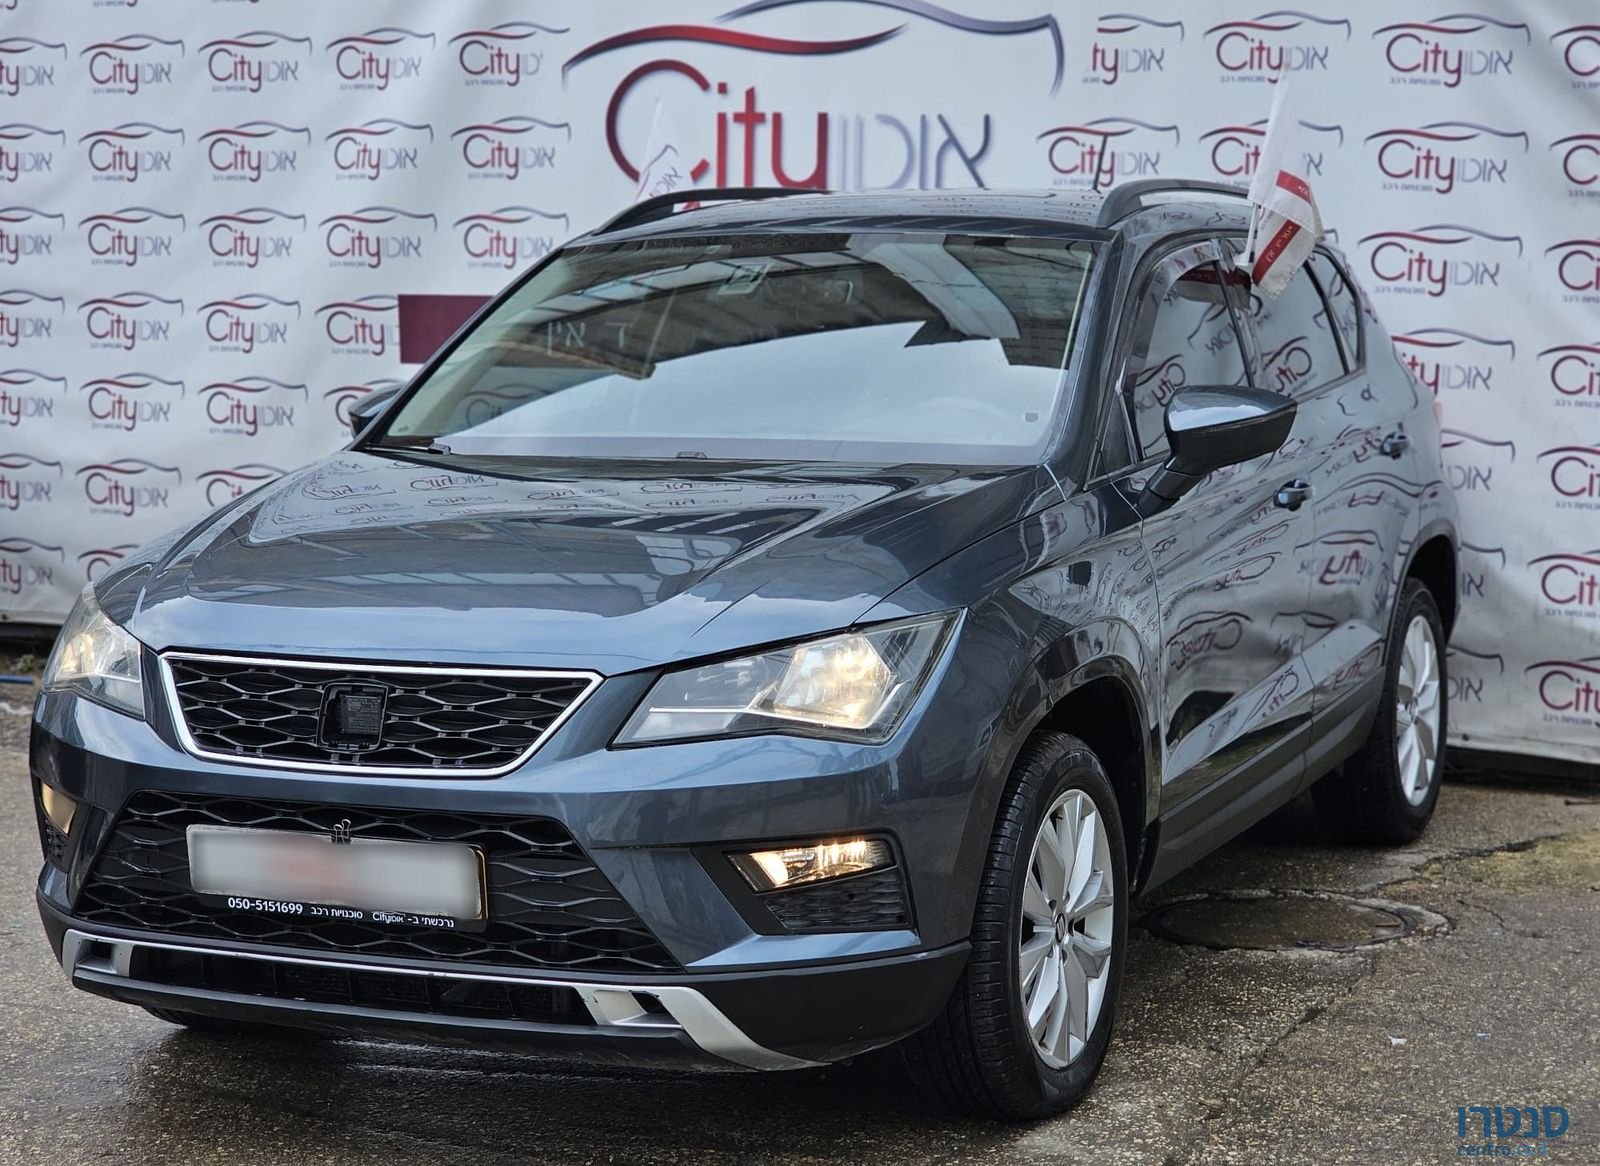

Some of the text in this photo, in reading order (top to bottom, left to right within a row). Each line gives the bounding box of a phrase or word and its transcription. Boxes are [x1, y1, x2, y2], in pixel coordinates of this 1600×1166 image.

[0, 61, 19, 97] ty
[89, 51, 140, 96] City
[208, 48, 262, 92] City
[335, 45, 390, 91] City
[460, 40, 520, 87] City
[1092, 42, 1119, 85] ty
[1216, 31, 1284, 84] City
[1386, 33, 1462, 88] City
[1462, 47, 1514, 76] אוטו
[0, 145, 19, 182] ty
[88, 138, 139, 183] City
[208, 137, 261, 182] City
[334, 137, 381, 181] City
[463, 134, 519, 180] City
[836, 114, 990, 190] אוטו
[1048, 136, 1115, 188] City
[1212, 137, 1262, 176] Cit
[1378, 139, 1508, 194] City אוטו
[0, 230, 19, 265] ty
[88, 223, 138, 267] City
[208, 224, 260, 268] City
[327, 223, 381, 269] City
[463, 223, 517, 269] City
[1371, 242, 1500, 297] City אוטו
[0, 313, 19, 349] ty
[87, 306, 137, 351] City
[206, 308, 255, 354] City
[327, 310, 385, 357] City
[0, 392, 20, 427] ty
[88, 387, 136, 431] City
[206, 391, 258, 436] City
[0, 475, 20, 512] ty
[85, 472, 135, 517] City
[0, 559, 20, 595] ty
[1541, 563, 1600, 605] Cit
[227, 897, 303, 915] 050-5151699
[310, 906, 329, 916] רכב
[330, 908, 363, 919] סוכנויות
[421, 915, 455, 928] נרכשתי
